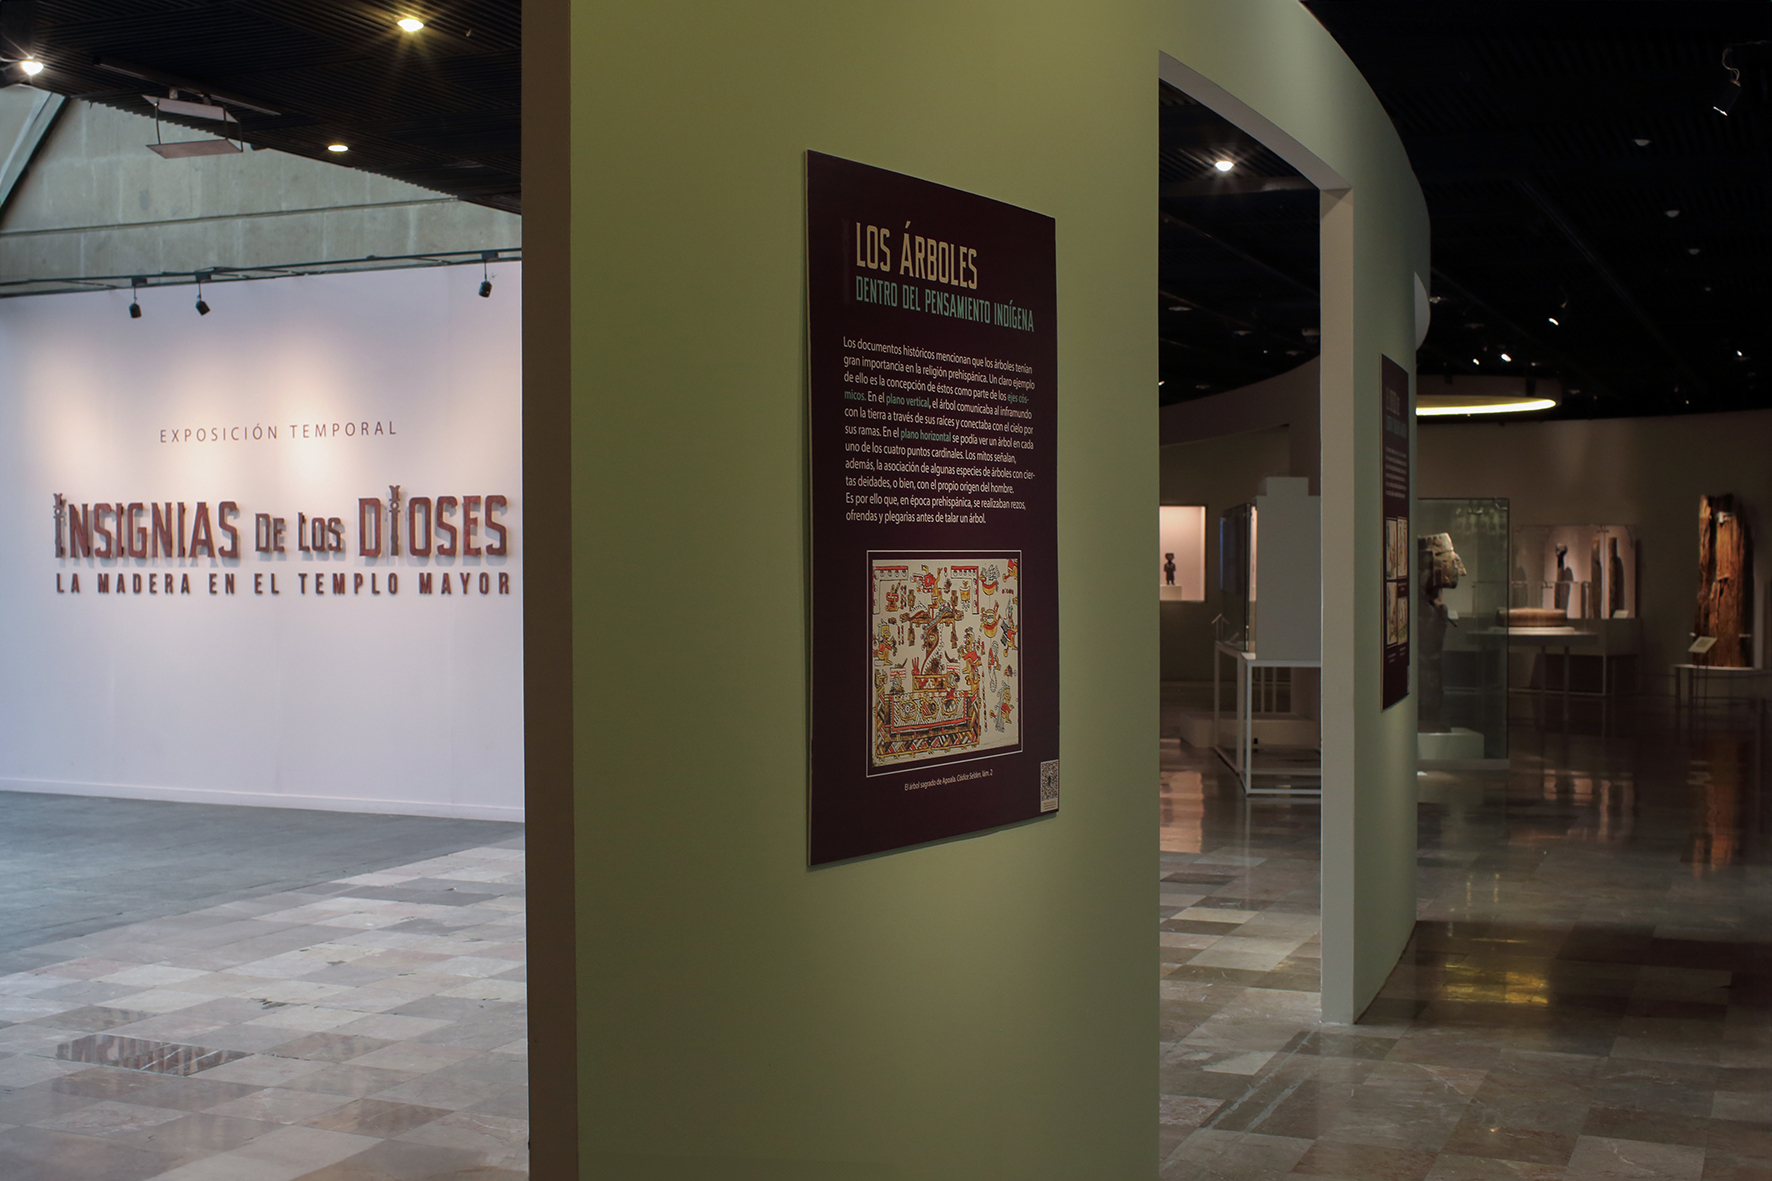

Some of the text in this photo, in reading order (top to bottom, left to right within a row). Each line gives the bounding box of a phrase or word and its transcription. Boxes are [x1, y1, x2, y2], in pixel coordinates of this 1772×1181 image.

[856, 220, 978, 289] LOS ÁRBOLES
[856, 276, 1034, 332] DENTRO DEL PENSAMIENTO INDÍGENA
[843, 336, 1032, 374] Los documentos históricos mencionan que los árboles tenían
[844, 356, 1036, 390] gran importancia en la religión prehispánica. Un claro ejemplo
[844, 370, 1029, 404] de ello es la concepción de éstos como parte de los ejes cós-
[844, 389, 1032, 420] micos. En el plano vertical, el árbol comunicaba al inframundo
[160, 421, 397, 443] EXPOSICIÓN TEMPORAL
[844, 406, 1034, 436] con la tierra a través de sus raíces y conectaba con el cielo por
[844, 426, 1034, 450] sus ramas. En el plano horizontal se podía ver un árbol en cada
[844, 441, 1016, 464] uno de los cuatro puntos cardinales. Los mitos señalan,
[844, 458, 1036, 480] además, la asociación de algunas especies de árboles con cier-
[845, 475, 1014, 494] tas deidades, o bien, con el propio origen del hombre.
[845, 492, 1026, 511] Es por ello que, en época prehispánica, se realizaban rezos,
[53, 493, 240, 558] INSIGNIAS
[358, 485, 508, 557] DIOSES
[845, 508, 986, 524] ofrendas y plegarias antes de talar un árbol.
[56, 572, 510, 595] LA MADERA EN EL TEMPLO MAYOR
